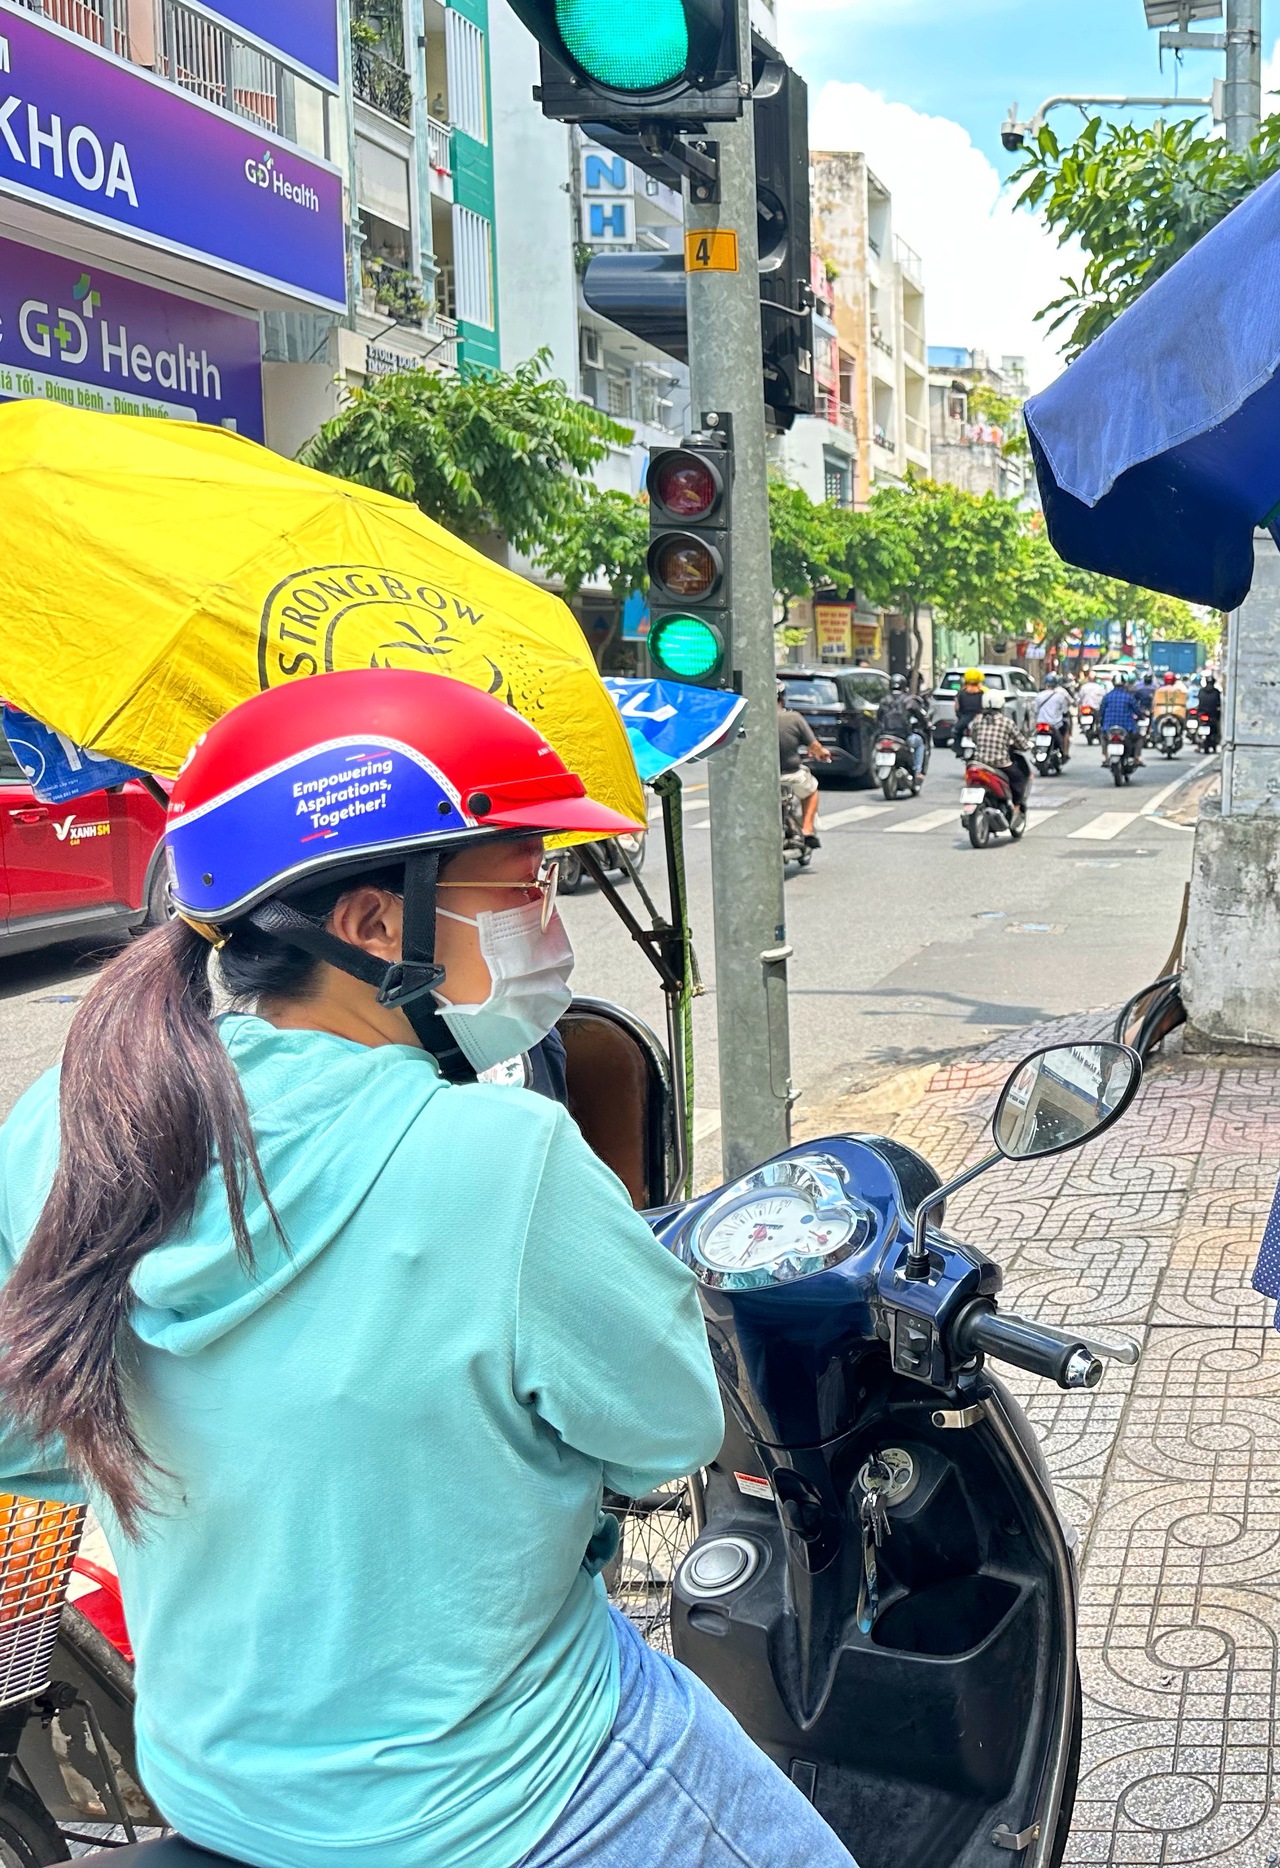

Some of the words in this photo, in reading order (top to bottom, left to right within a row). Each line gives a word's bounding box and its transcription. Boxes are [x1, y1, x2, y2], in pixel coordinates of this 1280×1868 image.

[0, 95, 139, 208] KHOA
[273, 169, 319, 213] Health
[695, 238, 711, 266] 4
[101, 319, 222, 401] Health
[0, 370, 12, 391] iá
[16, 373, 34, 395] Tốt
[45, 379, 74, 405] Đúng
[77, 387, 104, 411] bệnh
[279, 573, 484, 676] STRONGBOW
[293, 760, 393, 798] Empowering
[296, 779, 392, 816] Aspirations,
[310, 793, 387, 828] Together!
[70, 825, 97, 839] XANH
[97, 823, 110, 836] SM
